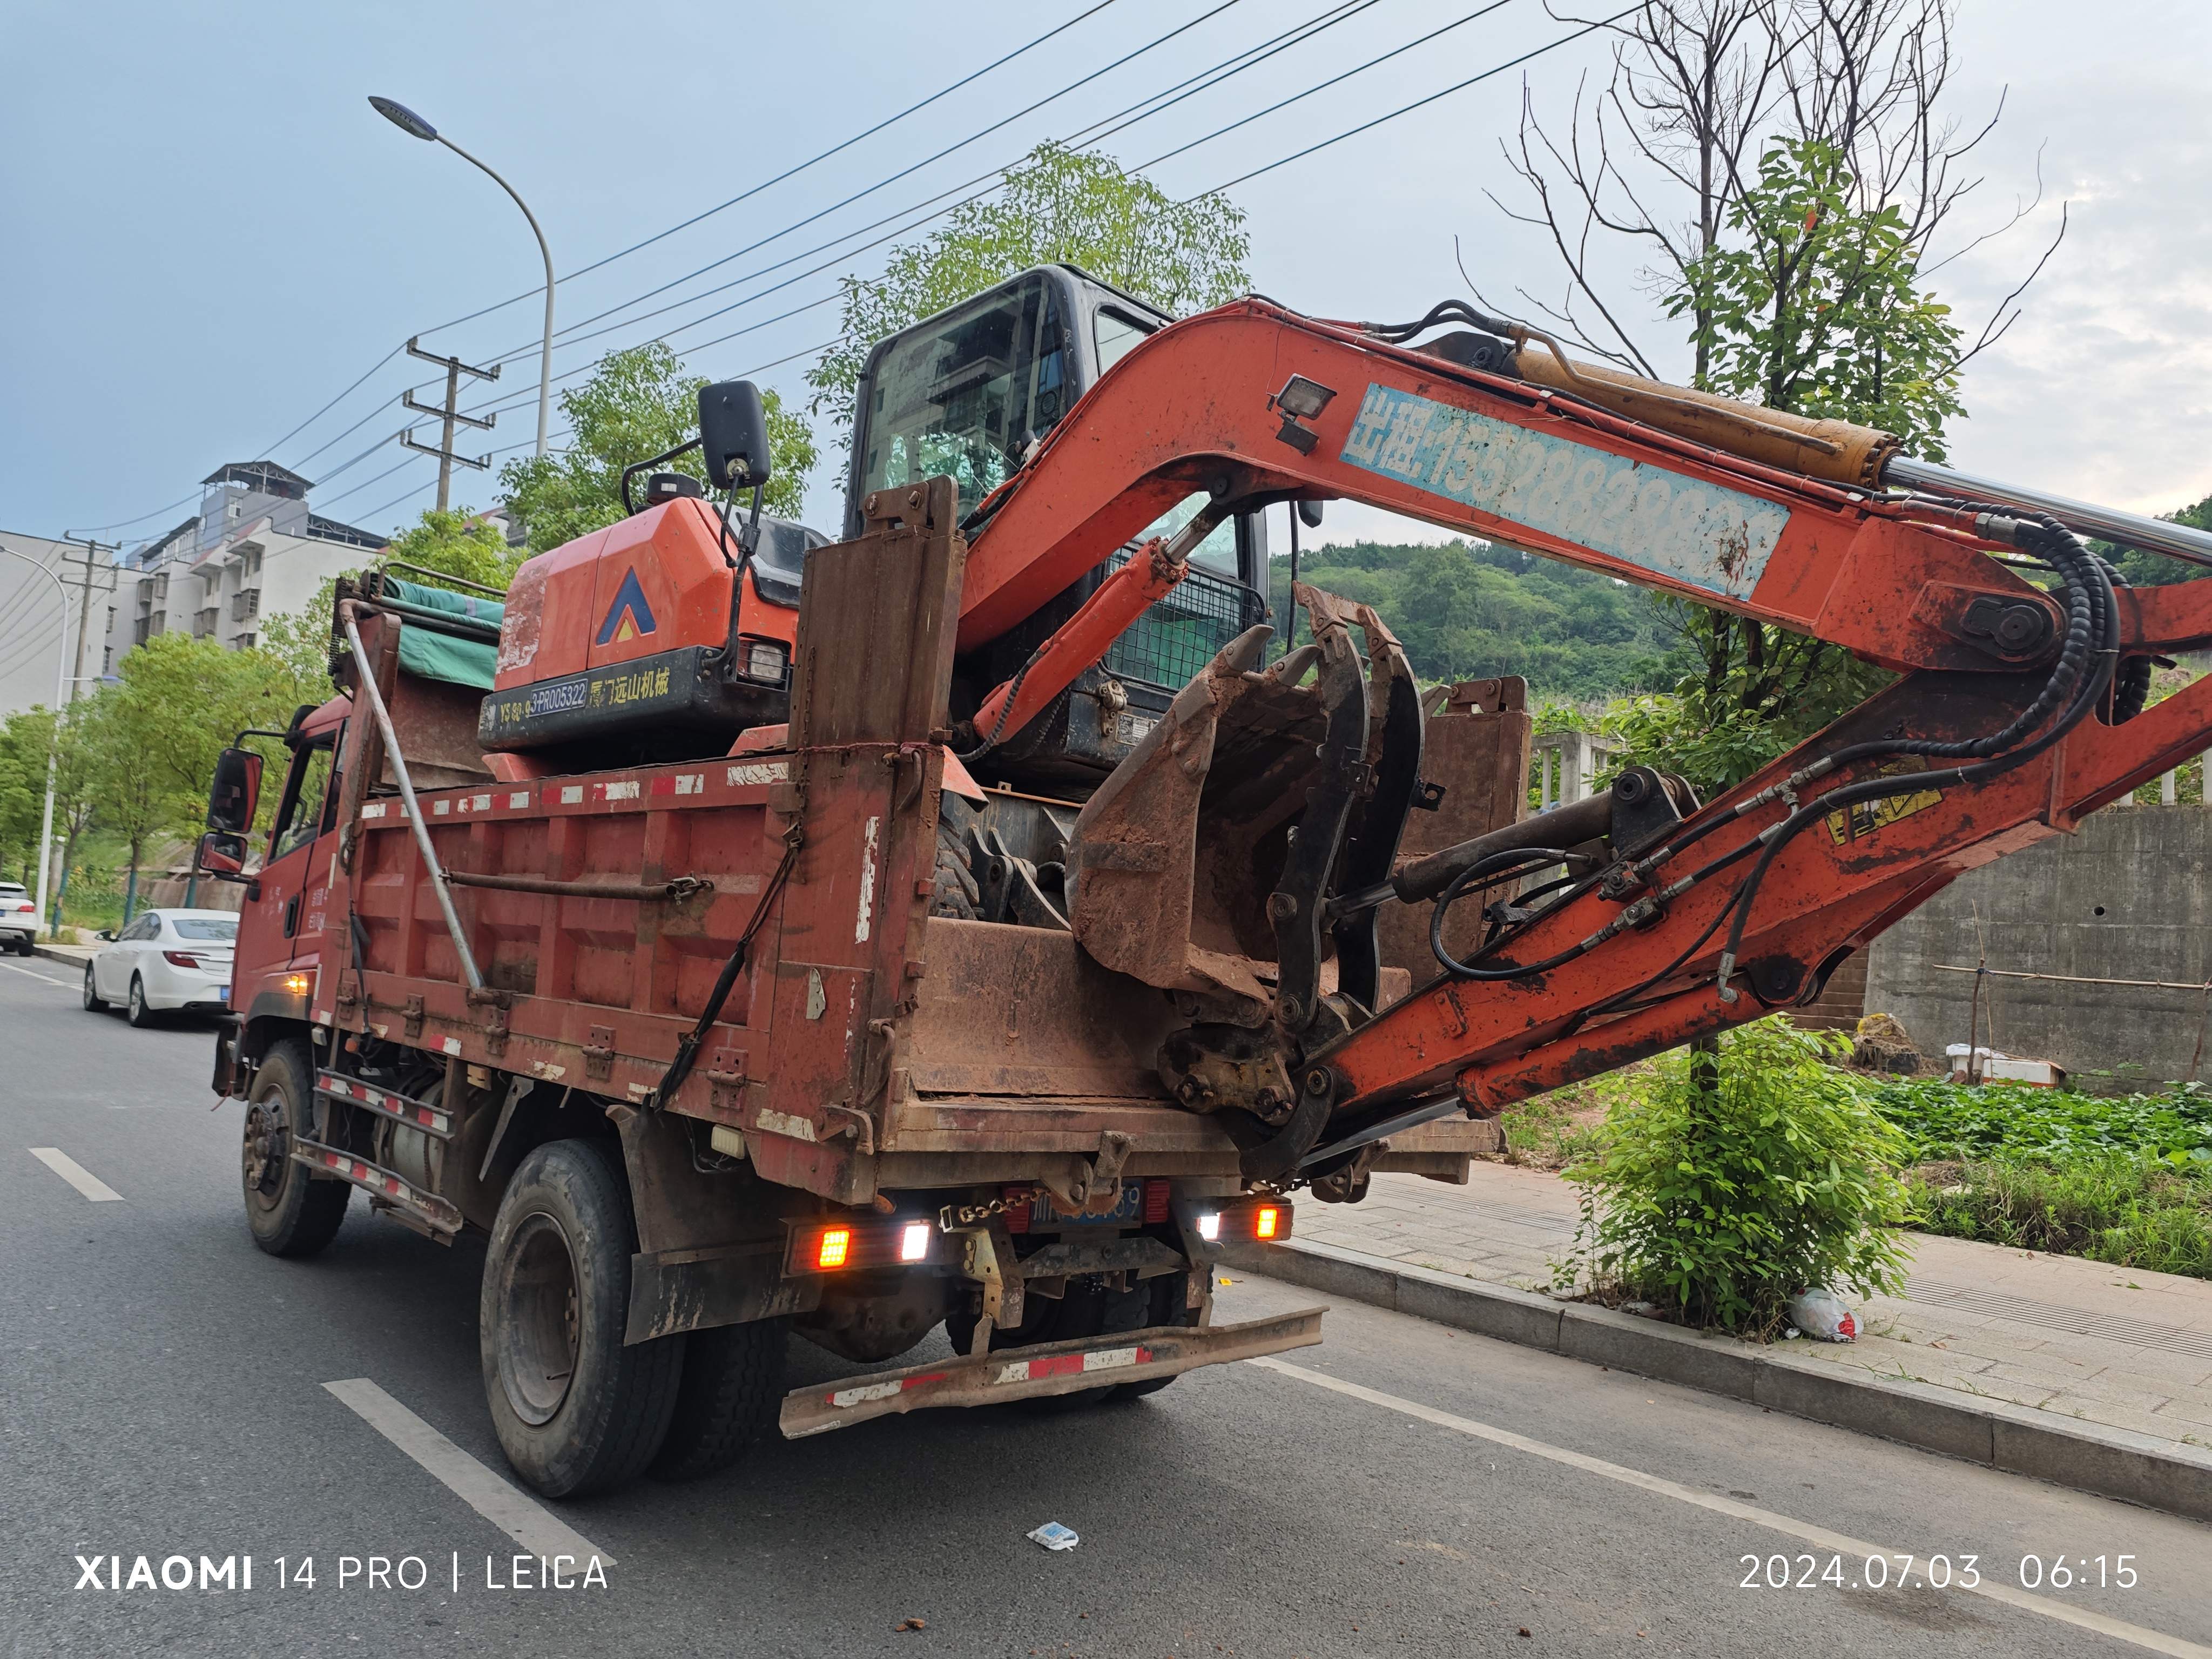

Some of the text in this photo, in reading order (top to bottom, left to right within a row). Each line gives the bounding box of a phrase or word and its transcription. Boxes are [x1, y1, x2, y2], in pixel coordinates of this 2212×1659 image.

[530, 682, 585, 714] 3-PR005322
[589, 666, 670, 708] 厦门远山机械
